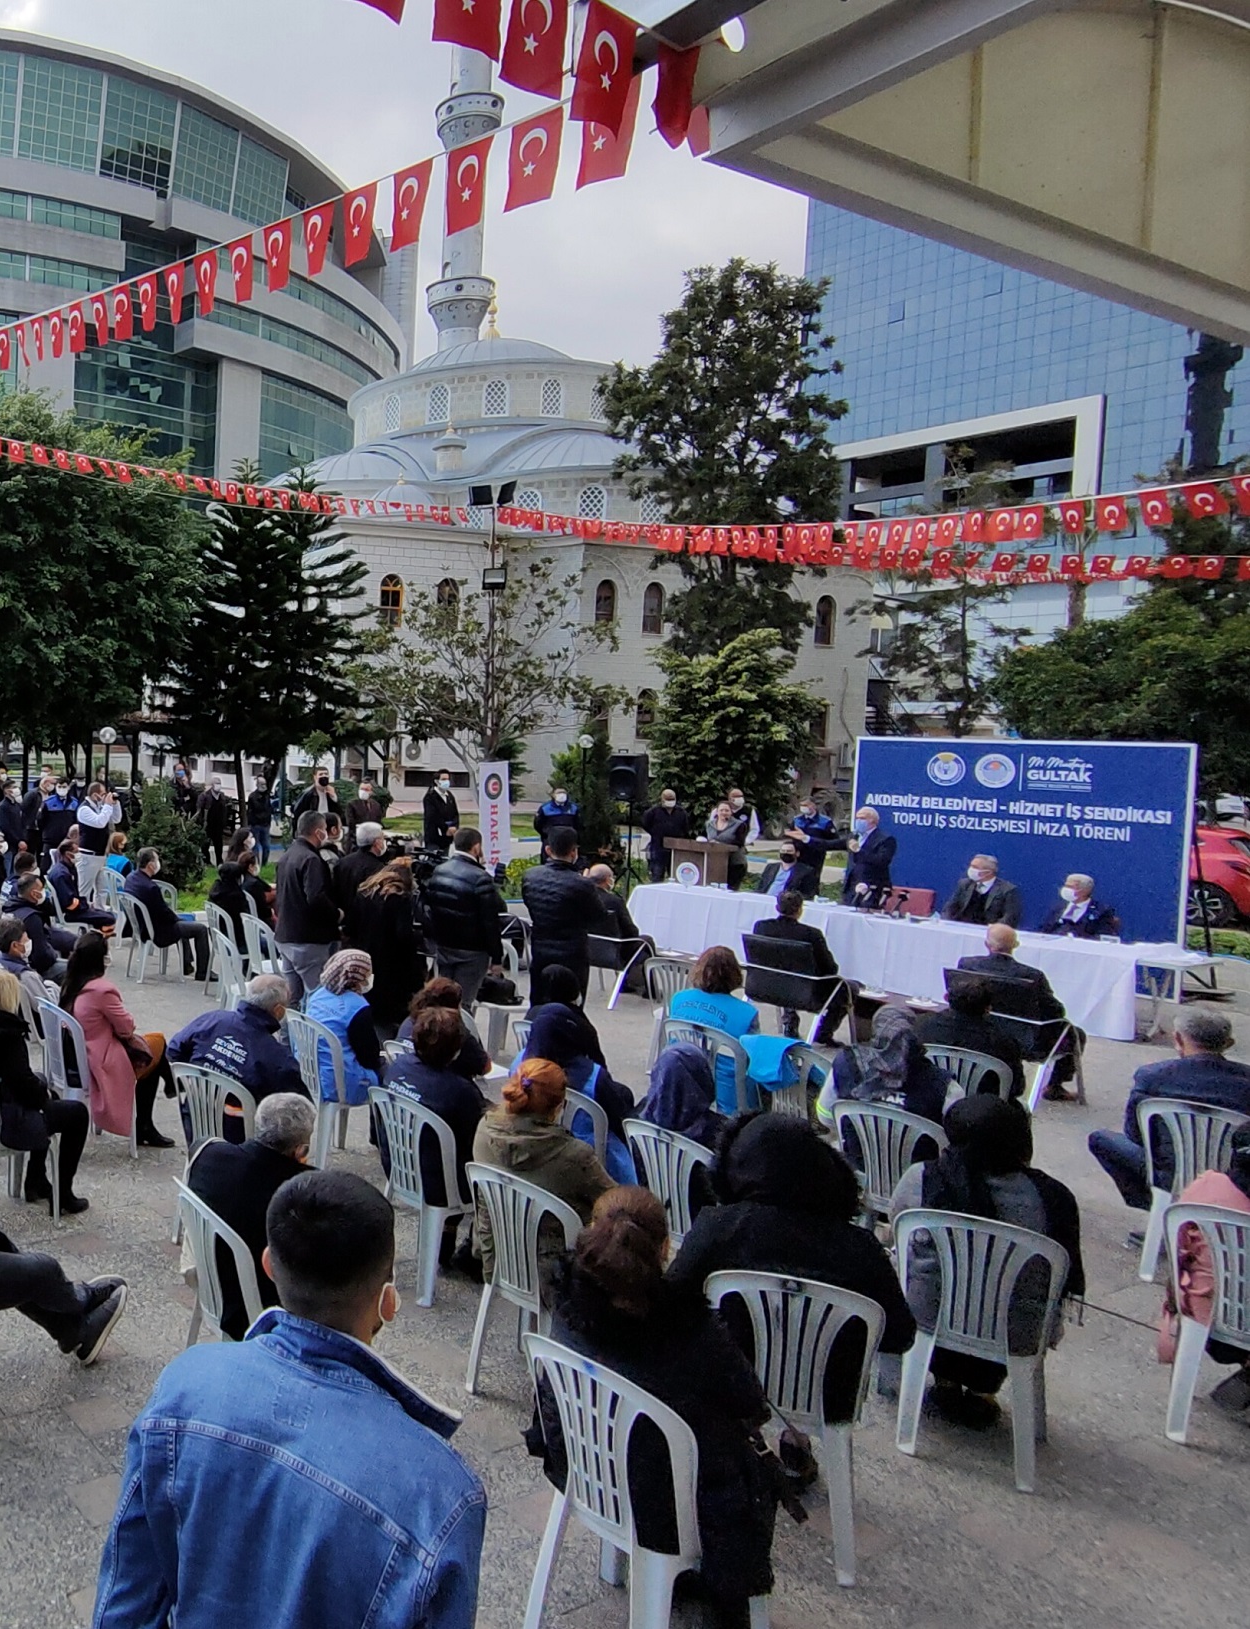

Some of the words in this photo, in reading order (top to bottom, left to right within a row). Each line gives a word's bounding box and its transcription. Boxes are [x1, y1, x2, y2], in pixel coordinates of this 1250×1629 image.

[865, 793, 920, 808] AKDENİZ
[922, 796, 998, 813] BELEDİYESİ
[1009, 800, 1063, 817] HİZMET
[1066, 803, 1081, 820] İŞ
[1083, 806, 1172, 824] SENDİKASI
[893, 811, 932, 826] TOPLU
[935, 813, 947, 829] İŞ
[949, 814, 1030, 834] SÖZLEŞMESİ
[1034, 820, 1070, 837] İMZA
[1074, 823, 1131, 842] TÖRENİ
